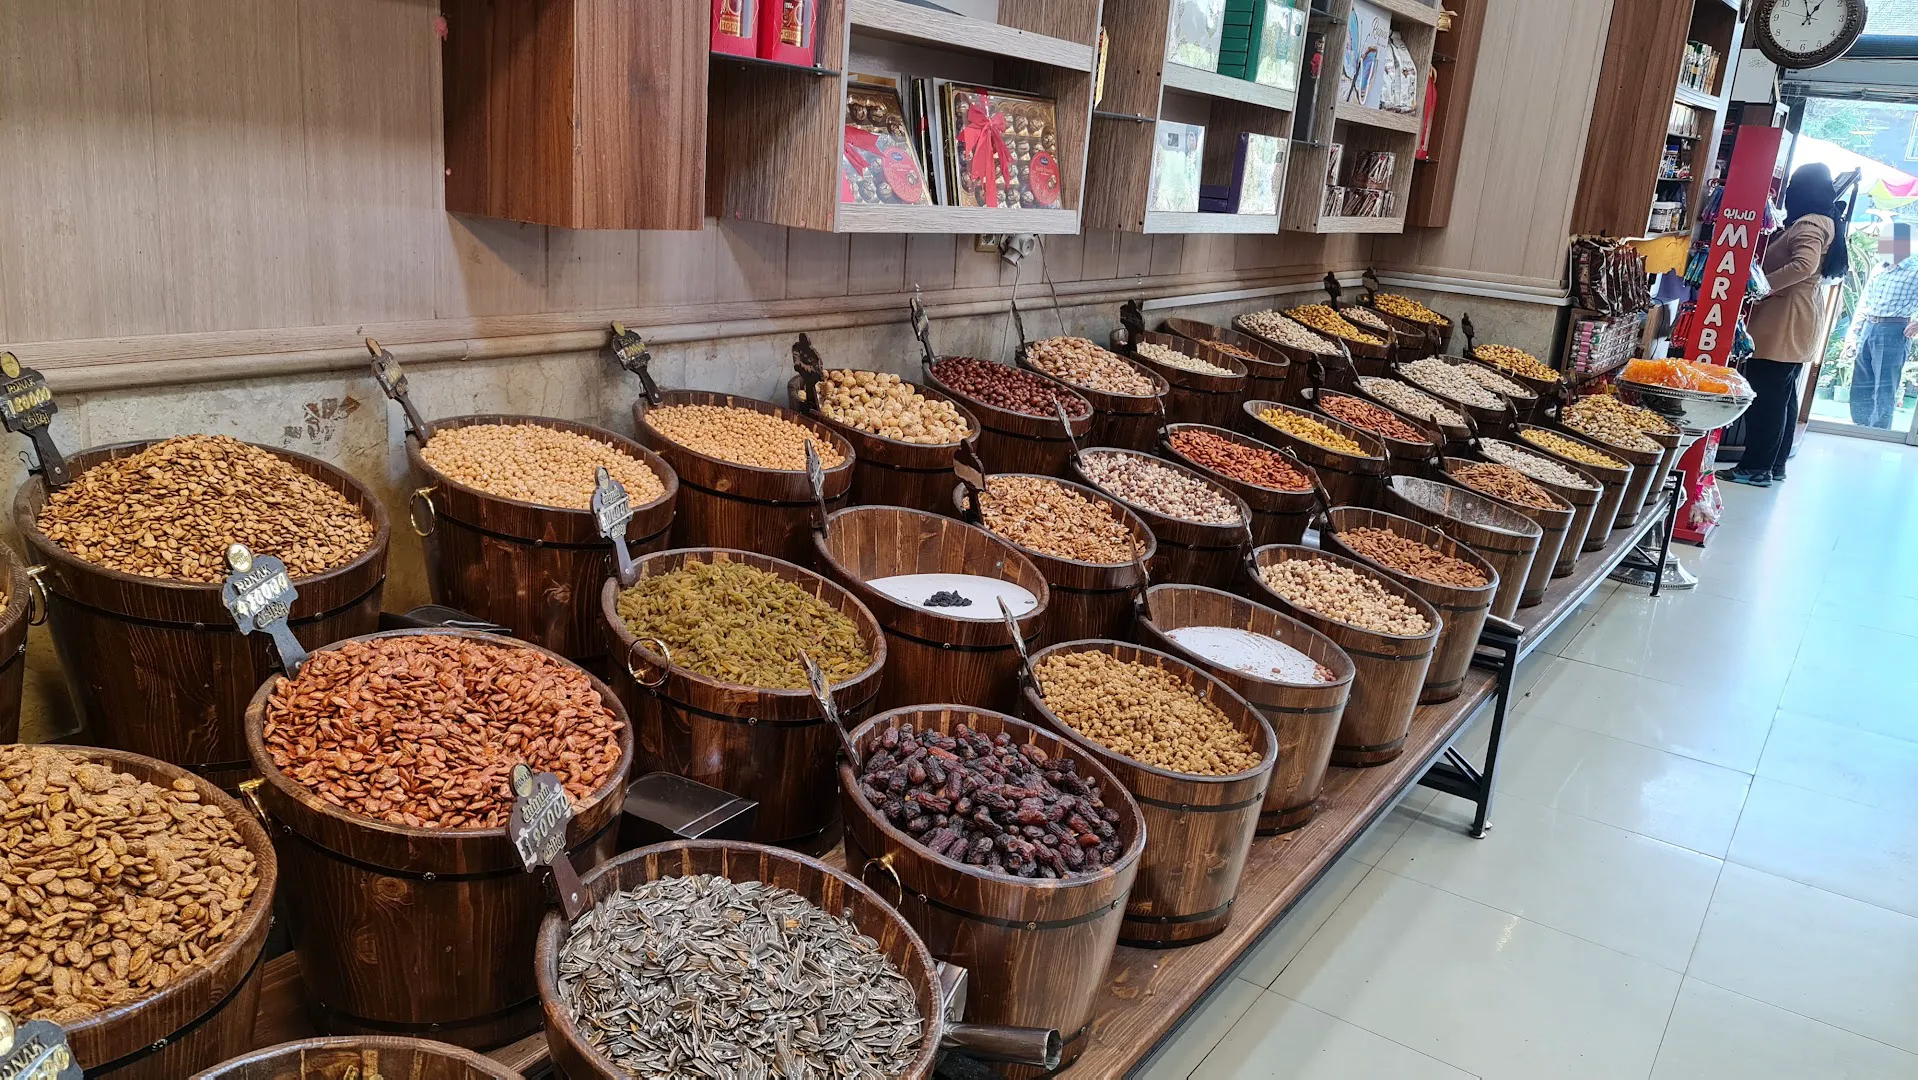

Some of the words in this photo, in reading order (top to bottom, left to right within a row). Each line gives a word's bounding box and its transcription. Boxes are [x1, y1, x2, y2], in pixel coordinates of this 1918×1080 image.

[1773, 14, 1780, 22] 9
[1838, 14, 1845, 23] 3
[1775, 28, 1781, 37] 8
[1830, 29, 1836, 37] 4
[1785, 39, 1791, 48] 7
[1799, 43, 1806, 52] 6
[1815, 39, 1822, 48] 5
[1723, 208, 1756, 221] مارابو
[7, 377, 36, 395] RONAK
[236, 564, 272, 594] RONAK
